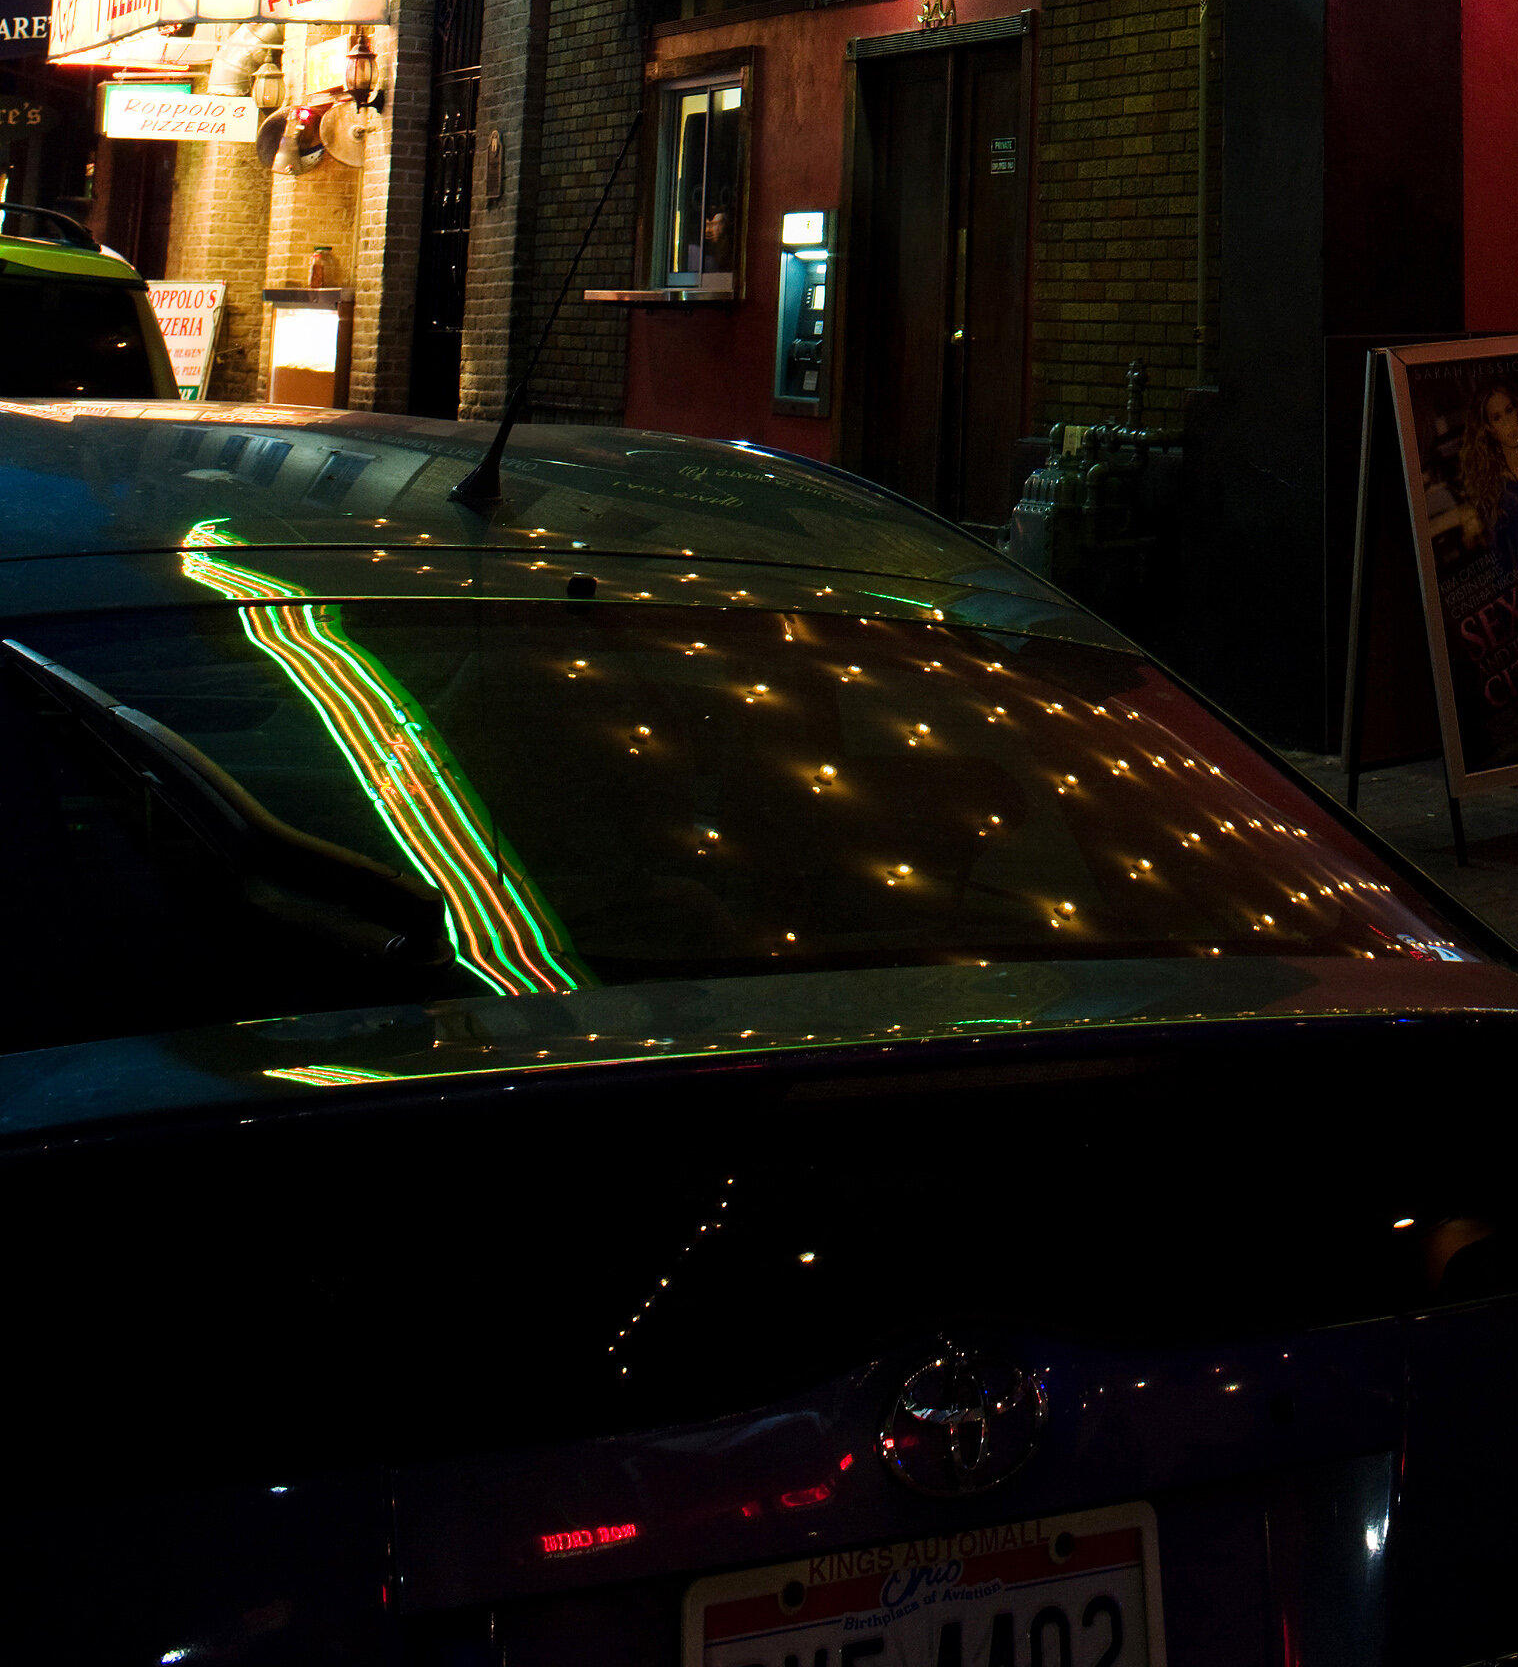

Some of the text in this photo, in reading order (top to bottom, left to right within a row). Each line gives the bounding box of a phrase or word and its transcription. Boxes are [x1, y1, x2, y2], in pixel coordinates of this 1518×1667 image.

[124, 99, 246, 121] Roppolo's
[141, 120, 225, 135] PIZZERIA
[149, 290, 217, 309] OPPOLO'S
[1414, 368, 1463, 380] SARAH
[808, 1521, 1048, 1584] KINGS AUTOMALL
[844, 1581, 1002, 1631] Birthplace of Aviation
